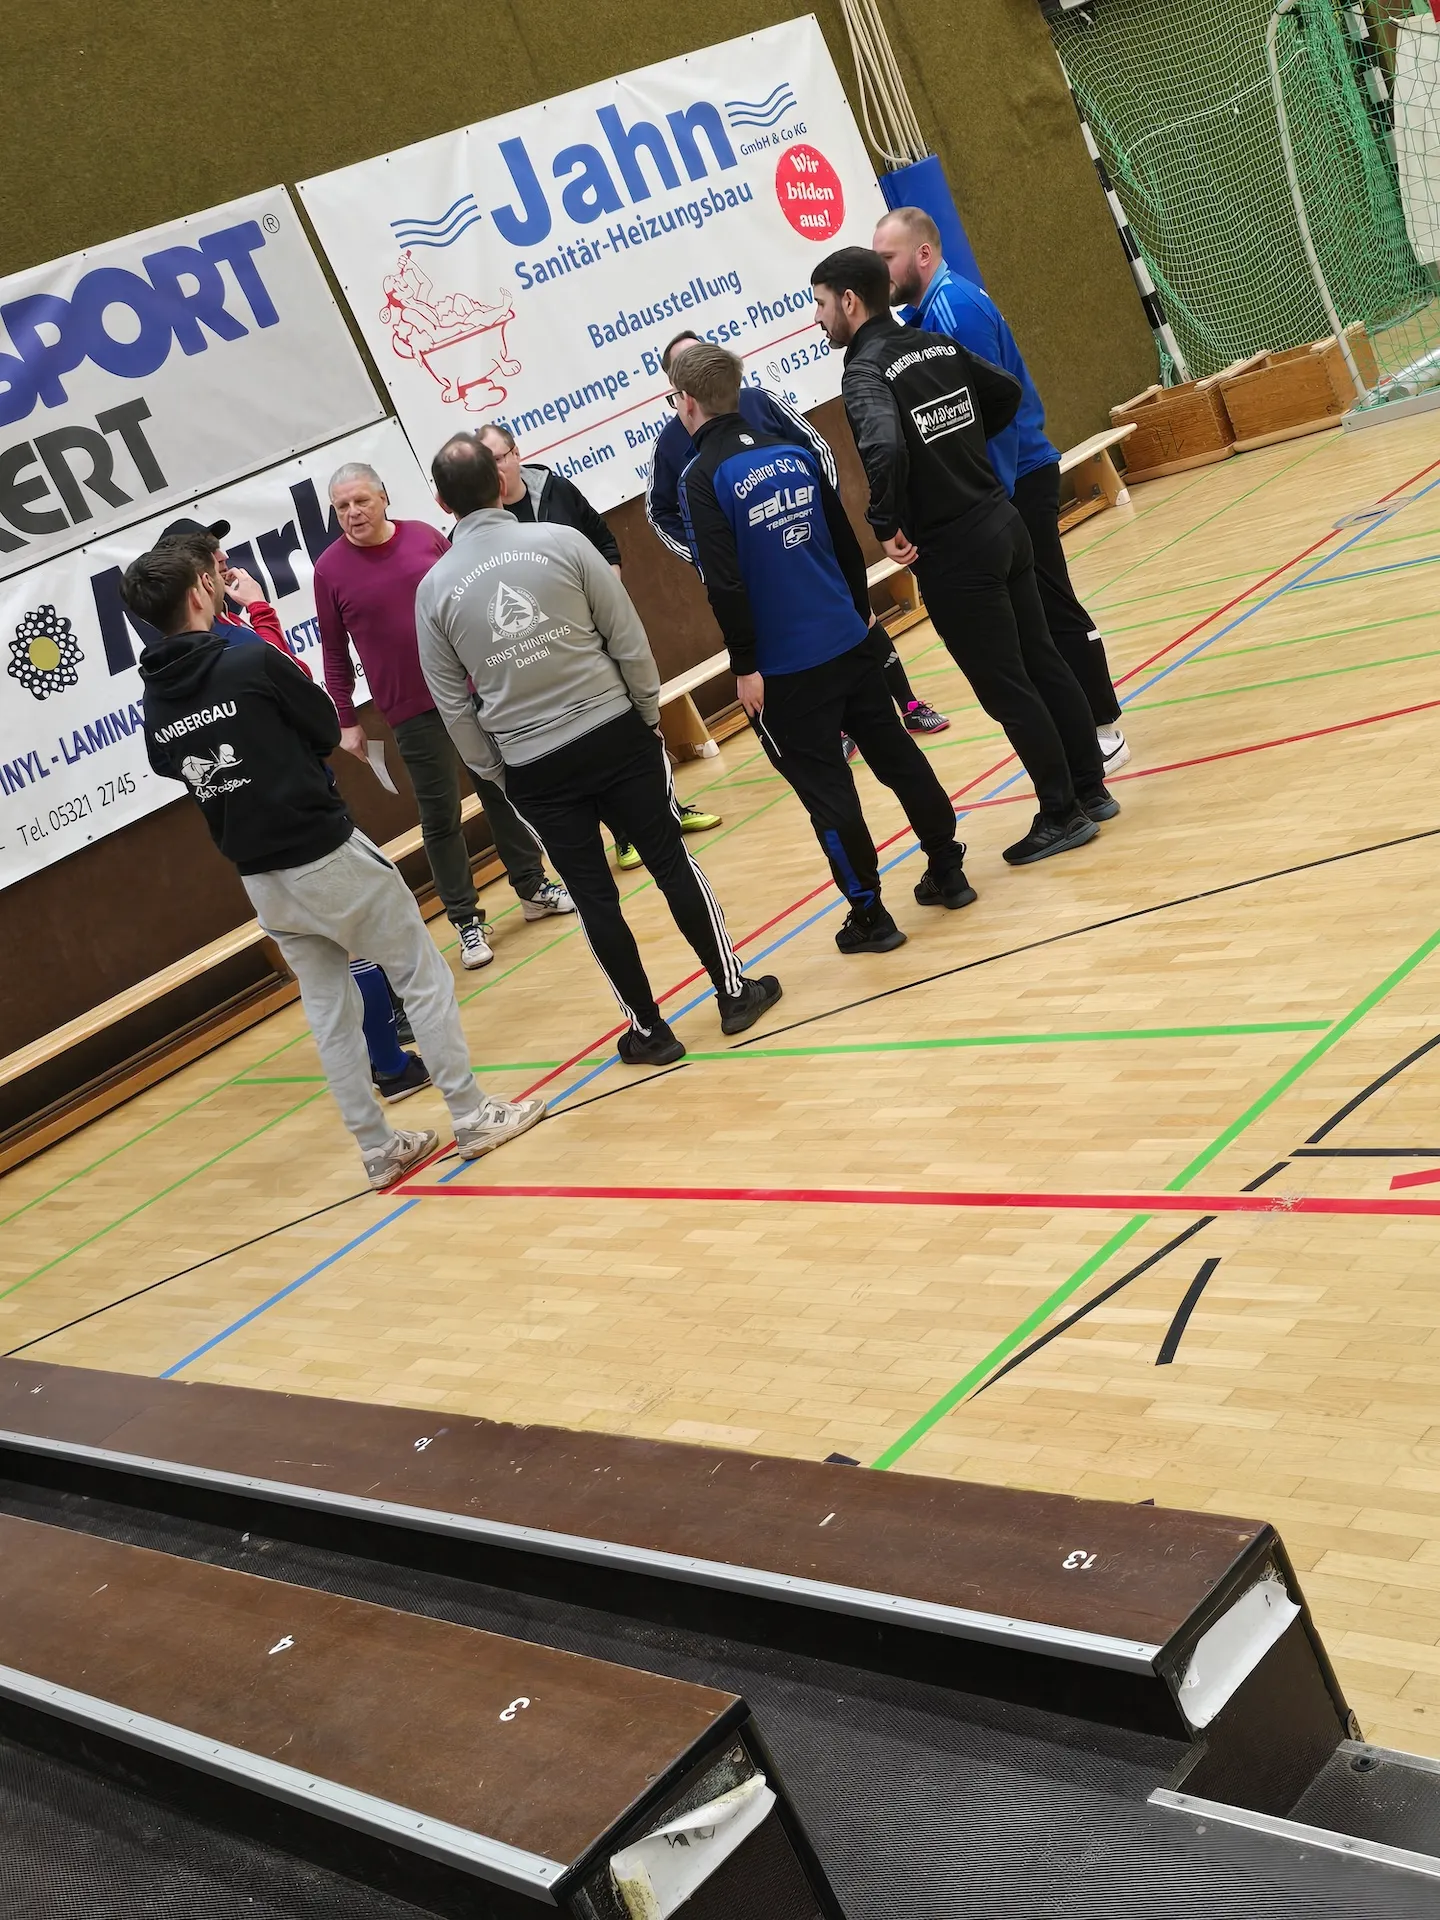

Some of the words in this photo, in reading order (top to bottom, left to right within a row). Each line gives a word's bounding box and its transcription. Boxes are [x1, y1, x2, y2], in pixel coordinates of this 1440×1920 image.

[740, 135, 771, 156] GmbH
[772, 132, 781, 145] &
[781, 129, 793, 140] Co
[793, 122, 808, 135] KG
[490, 101, 738, 247] Jahn
[790, 152, 820, 173] Wir
[786, 181, 835, 201] bilden
[514, 182, 754, 290] Sanitär-Heizungsbau
[800, 209, 832, 227] aus!
[587, 269, 743, 349] Badausstellung
[474, 367, 631, 439] ärmepumpe
[0, 396, 169, 554] ERT
[734, 463, 777, 500] Goslarer
[775, 458, 795, 474] SC
[451, 586, 465, 602] SG
[461, 550, 549, 588] Jerstedt/Dörnten
[485, 645, 518, 668] ERNST
[519, 624, 571, 653] HINRICHS
[515, 646, 551, 669] Dental
[154, 700, 238, 744] AMBERGAU
[17, 817, 48, 846] Tel.
[49, 794, 94, 831] 05321
[97, 772, 137, 807] 2745
[268, 1634, 295, 1655] 4
[499, 1696, 531, 1722] 3
